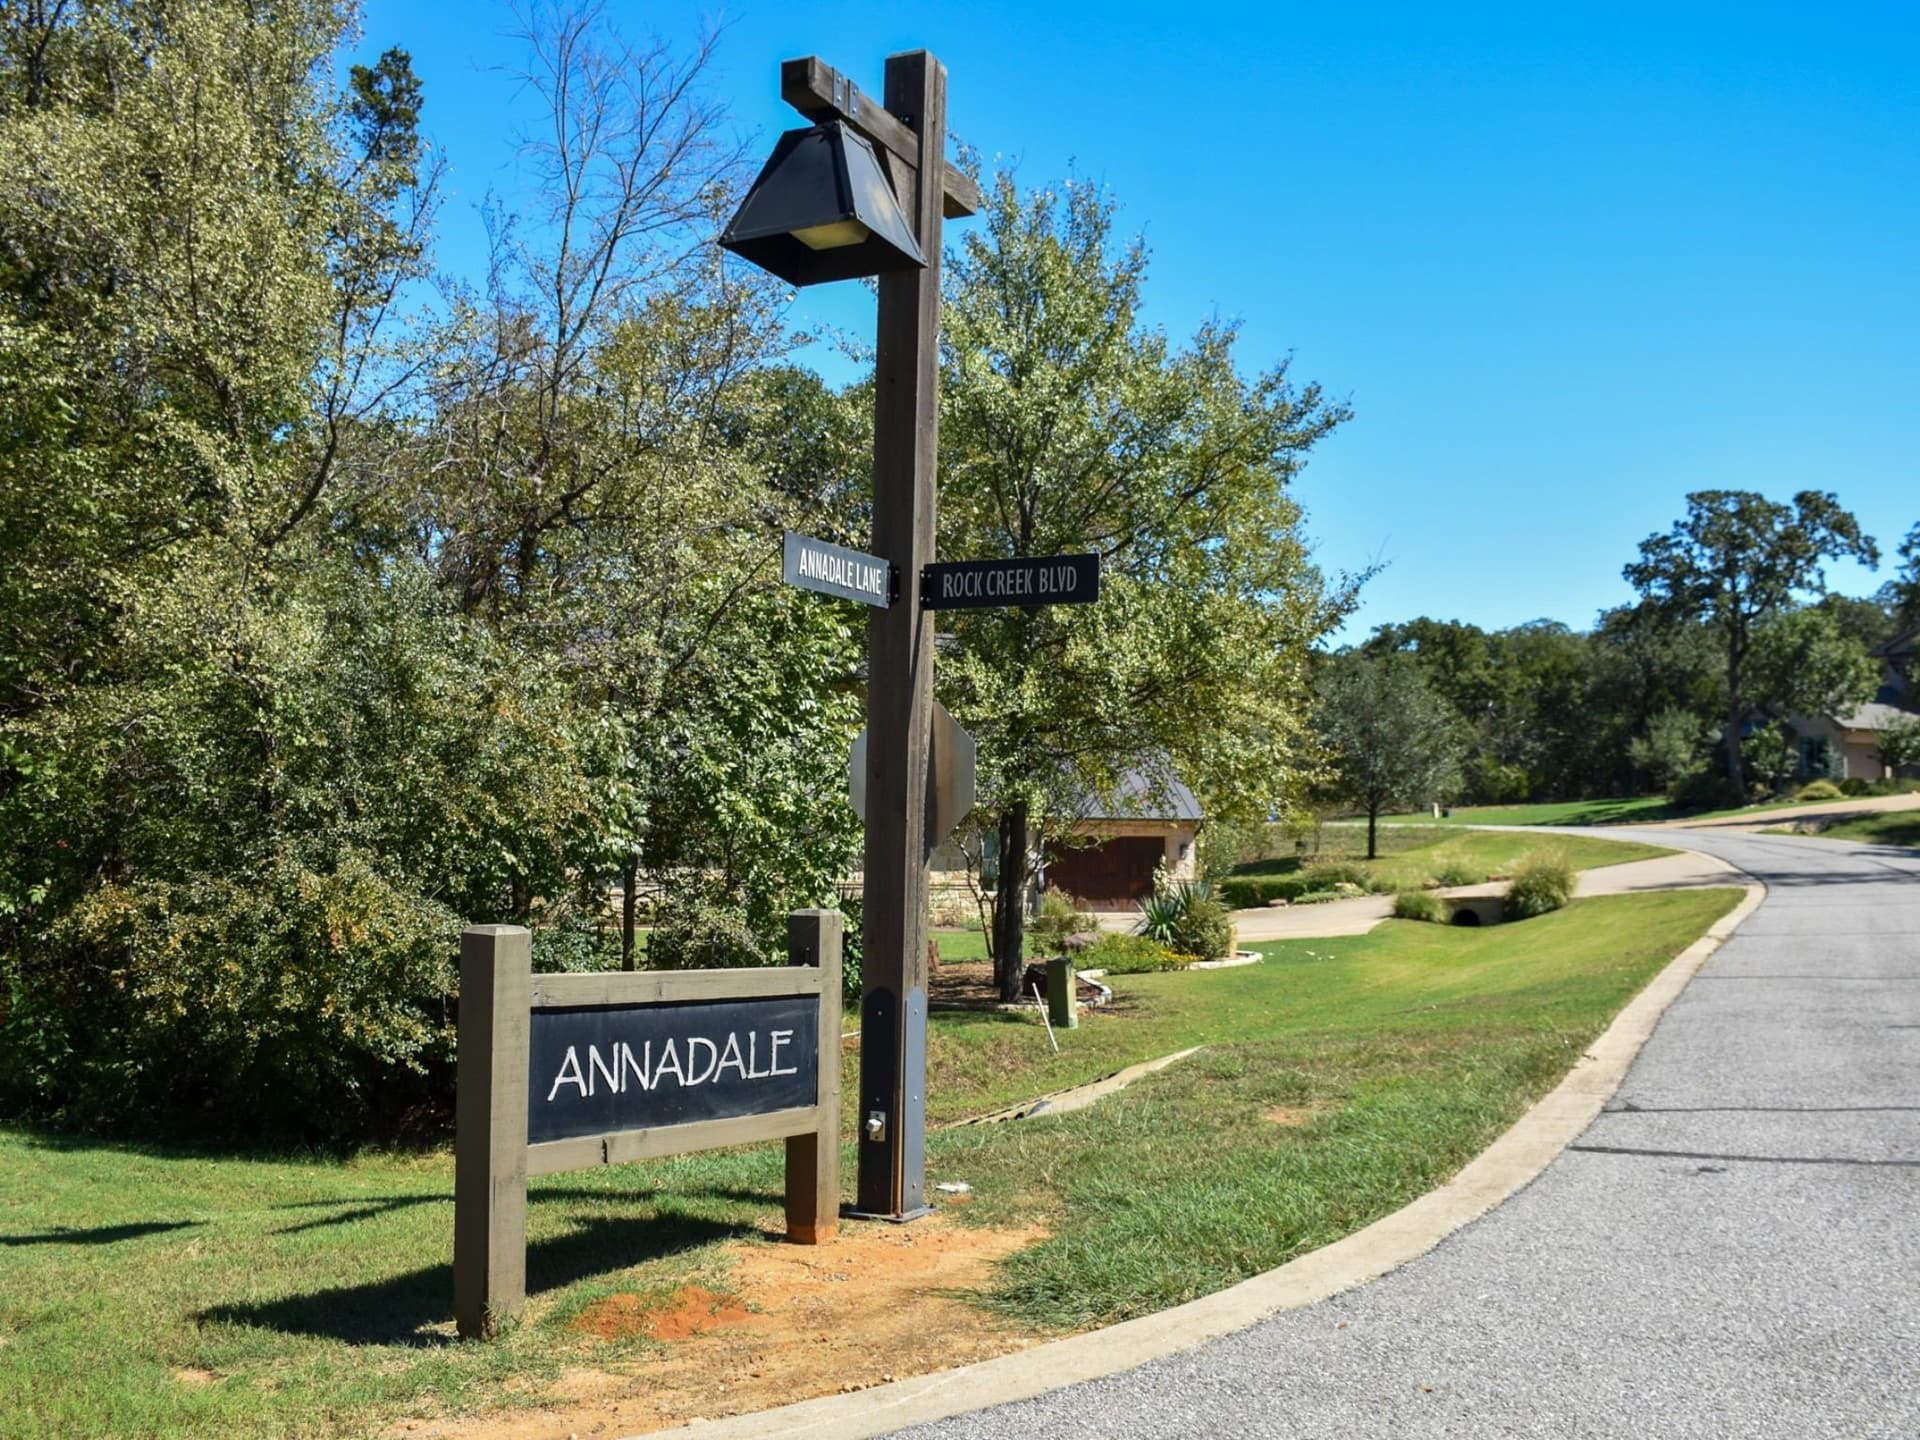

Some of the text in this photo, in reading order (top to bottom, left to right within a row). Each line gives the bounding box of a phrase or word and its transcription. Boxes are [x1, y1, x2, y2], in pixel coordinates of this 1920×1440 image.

[799, 549, 882, 595] ANNADALE LANE
[943, 565, 1078, 598] ROCK CREEK BLVD
[547, 1029, 798, 1101] ANNADALE
